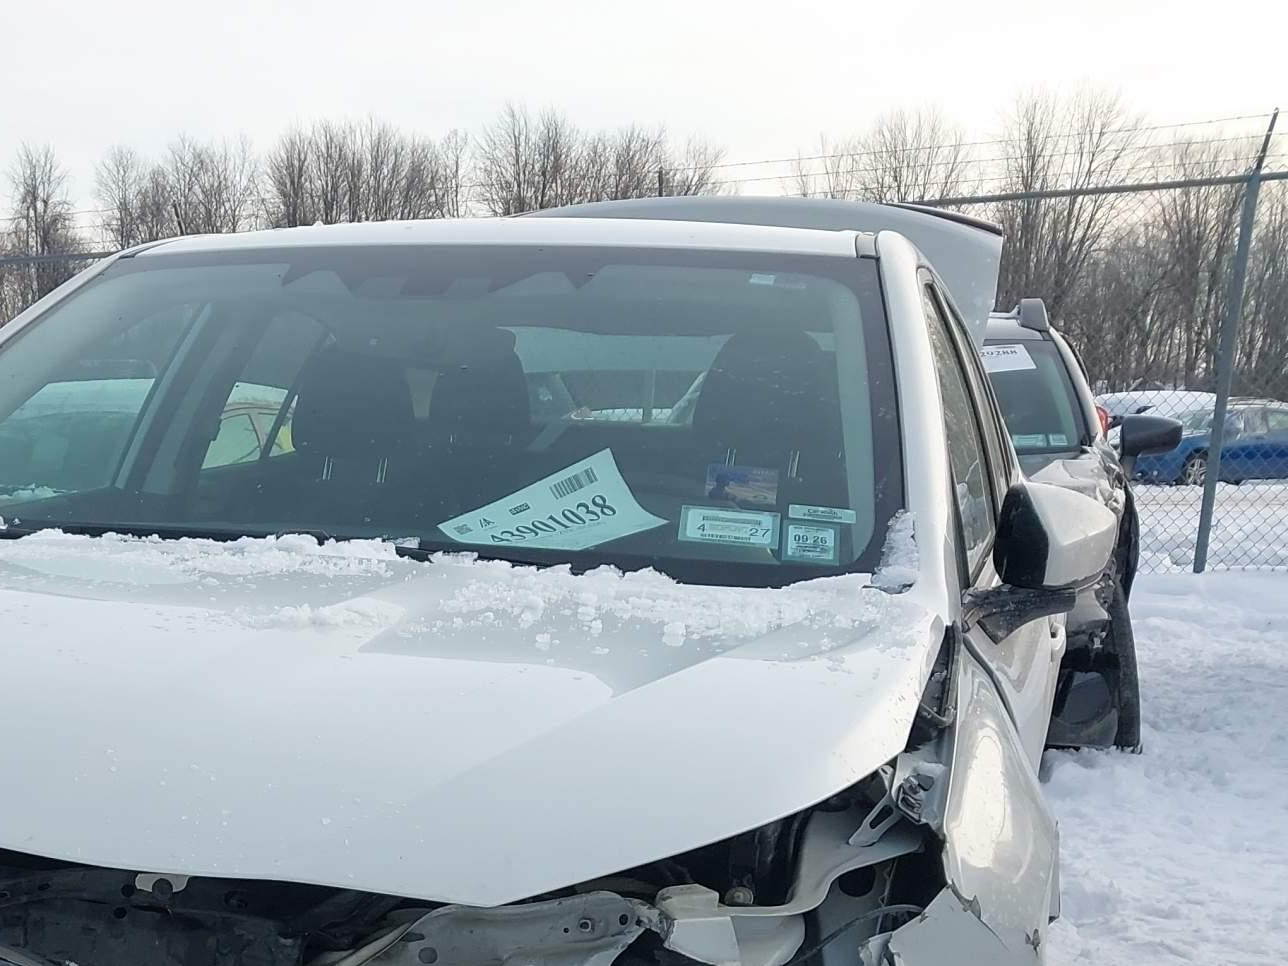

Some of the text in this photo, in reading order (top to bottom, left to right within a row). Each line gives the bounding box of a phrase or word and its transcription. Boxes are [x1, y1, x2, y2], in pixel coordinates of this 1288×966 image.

[490, 494, 617, 544] 43901038
[696, 522, 707, 533] 4
[749, 527, 771, 539] 27
[793, 533, 828, 545] 09 26
